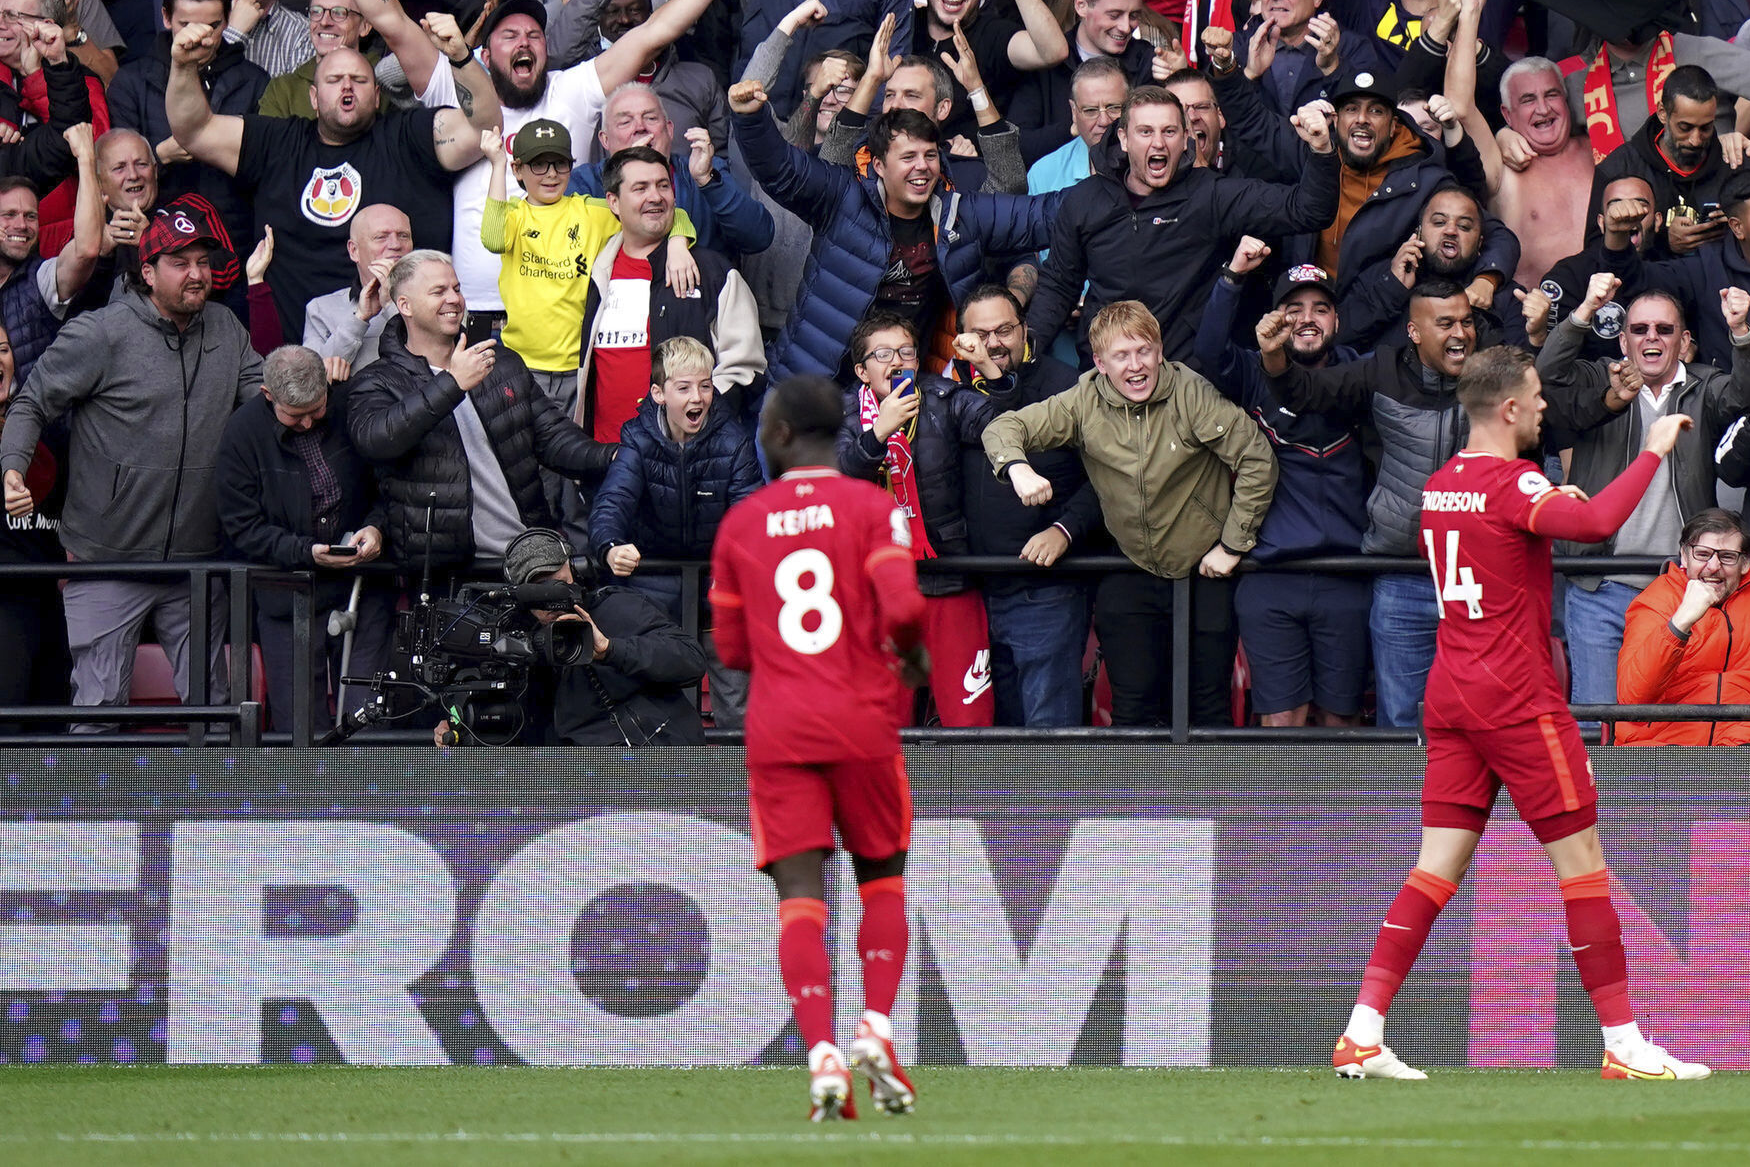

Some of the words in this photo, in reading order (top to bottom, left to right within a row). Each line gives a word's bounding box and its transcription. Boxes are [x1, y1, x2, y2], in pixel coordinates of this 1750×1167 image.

[518, 265, 573, 280] Chartered
[521, 250, 570, 268] Standard
[766, 504, 835, 537] KEITA
[1423, 529, 1483, 619] 14
[774, 547, 844, 655] 8
